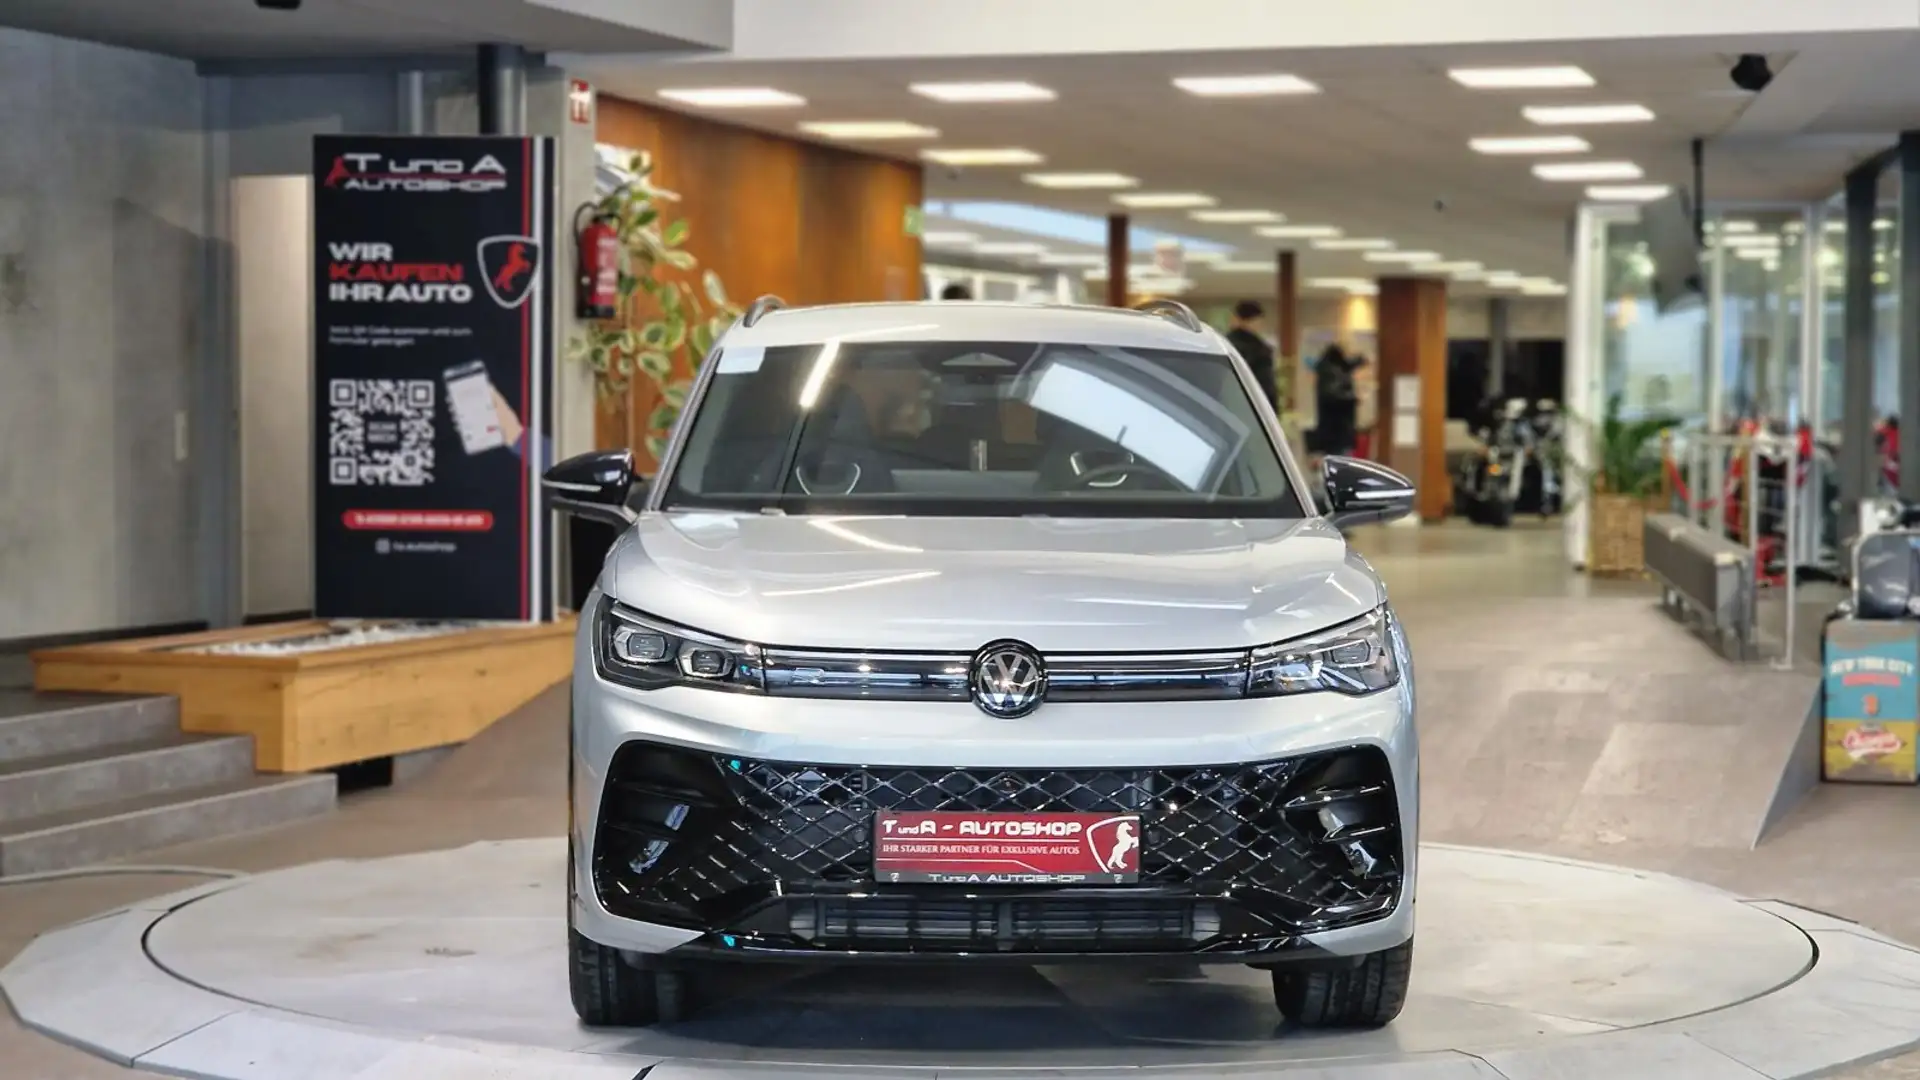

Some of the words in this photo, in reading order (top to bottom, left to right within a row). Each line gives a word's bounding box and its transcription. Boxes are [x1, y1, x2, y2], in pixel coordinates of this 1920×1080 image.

[344, 153, 381, 173] T
[470, 154, 506, 175] A
[344, 179, 507, 191] AUTOSHOP
[328, 242, 393, 261] WIR
[329, 263, 464, 281] KAUFEN
[329, 282, 384, 301] IHR
[386, 283, 473, 303] AUTO
[959, 821, 1083, 836] AUTOSHOP
[939, 845, 980, 853] PARTNER
[981, 845, 1000, 854] FÜR
[1000, 845, 1048, 854] EXKLUSIVE
[1049, 846, 1080, 855] AUTOS
[986, 874, 1086, 882] AUTOSHOP
